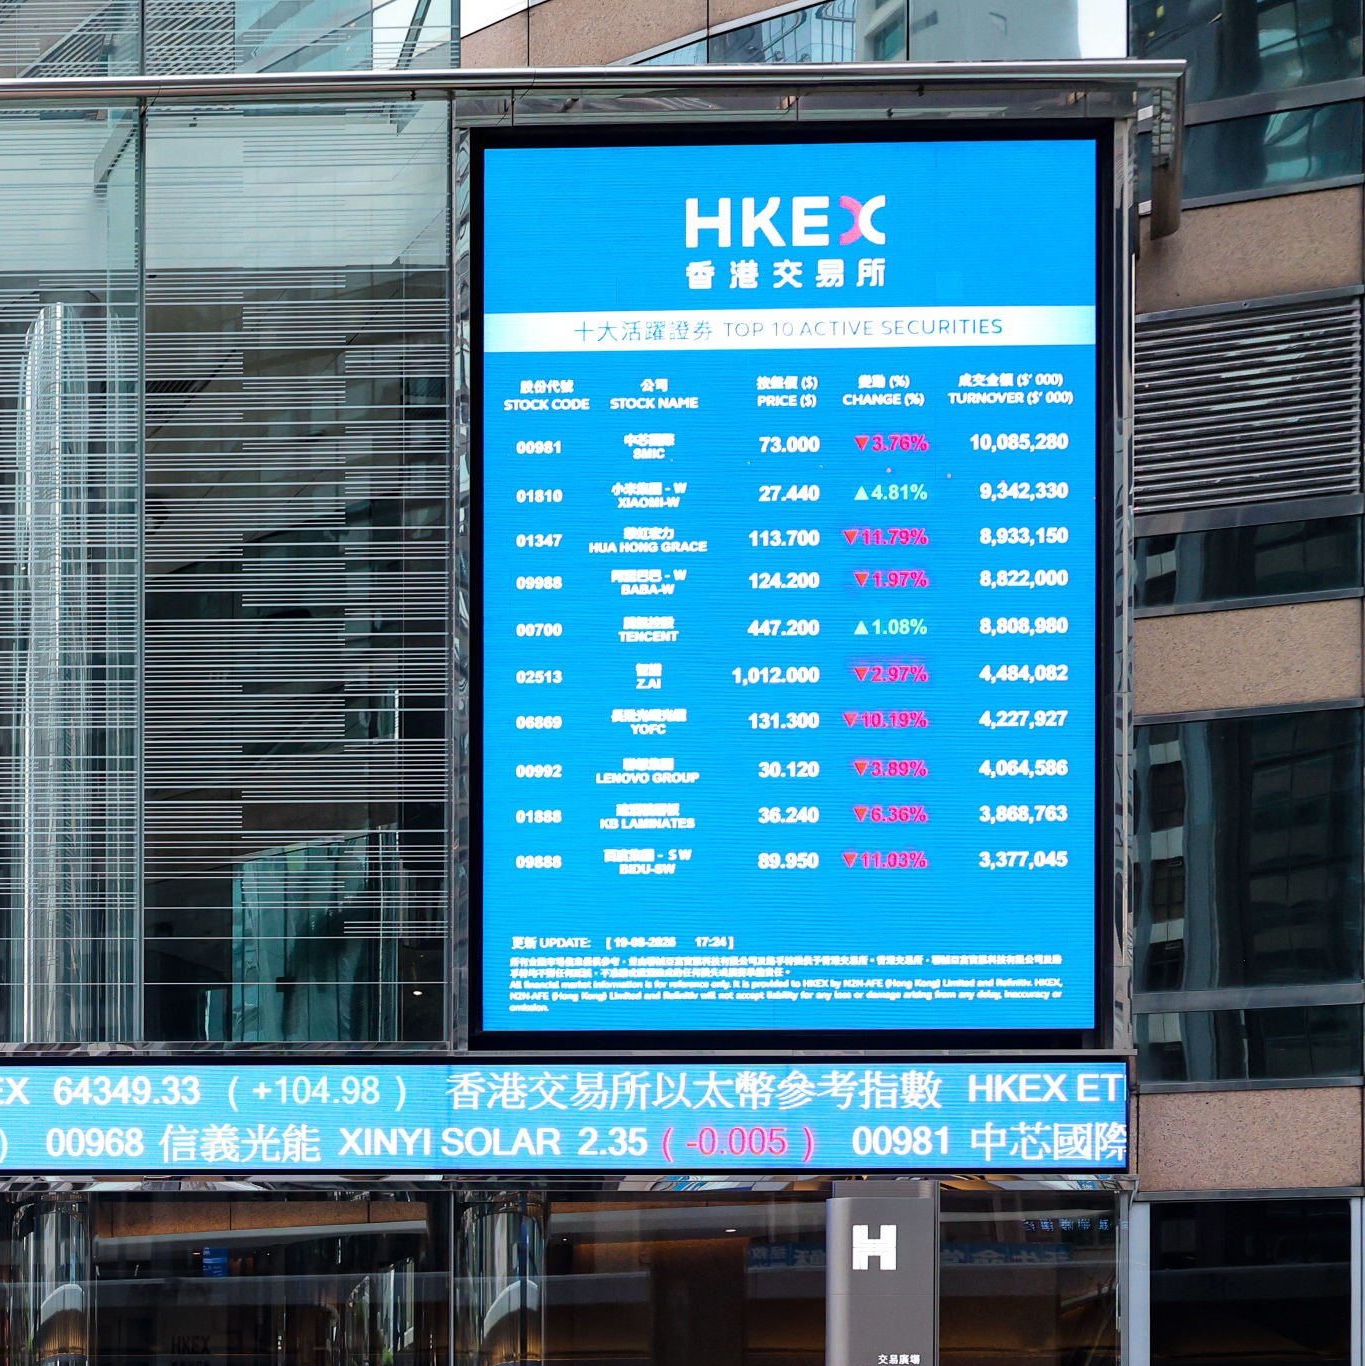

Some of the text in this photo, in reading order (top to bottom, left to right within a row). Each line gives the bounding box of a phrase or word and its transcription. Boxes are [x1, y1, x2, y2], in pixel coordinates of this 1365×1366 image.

[686, 195, 885, 248] HKEX
[686, 258, 885, 289] 香港交易所
[573, 318, 1003, 343] 十大活躍證券 TOP 10 ACTIVE SECURITIES
[641, 379, 668, 392] 公司
[504, 399, 589, 410] STOCK CODE
[610, 397, 698, 409] STOCK NAME
[758, 395, 797, 406] PRICE
[843, 394, 901, 405] CHANGE
[948, 392, 1024, 404] TURNOVER
[517, 441, 561, 454] 00981
[759, 436, 820, 452] 73.000
[873, 435, 929, 451] 3.76%
[971, 433, 1069, 452] 10,085,280
[633, 448, 665, 459] SMIC
[517, 489, 563, 502] 01810
[759, 485, 820, 501] 27.440
[872, 484, 927, 499] 4.81%
[980, 480, 1068, 501] 9,342,330
[618, 497, 680, 508] XIAOMI-W
[517, 534, 562, 547] 01347
[749, 530, 820, 546] 113.700
[861, 529, 929, 544] 11.79%
[980, 527, 1068, 546] 8,933,150
[589, 541, 707, 553] HUA HONG GRACE
[749, 572, 820, 588] 124.200
[873, 571, 929, 587] 1.97%
[980, 570, 1068, 588] 8,822,000
[621, 584, 675, 595] BABA-W
[517, 623, 562, 636] 00700
[748, 620, 819, 636] 447.200
[873, 619, 927, 634] 1.08%
[980, 617, 1068, 636] 8,808,980
[619, 631, 679, 642] TENCENT
[516, 670, 562, 683] 02513
[732, 667, 820, 686] 1,012.000
[872, 666, 927, 682] 2.97%
[979, 665, 1068, 683] 4,484,082
[636, 679, 661, 689] Z.AI
[749, 712, 819, 729] 131.300
[862, 711, 928, 728] 10.19%
[979, 710, 1068, 729] 4,227,927
[631, 724, 666, 734] YOFC
[516, 765, 562, 777] 00992
[759, 761, 819, 777] 30.120
[871, 761, 927, 776] 3.89%
[979, 760, 1068, 778] 4,064,586
[596, 772, 699, 783] LENOVO GROUP
[759, 807, 819, 823] 36.240
[871, 806, 926, 822] 6.36%
[980, 805, 1068, 824] 3,868,763
[600, 818, 695, 829] KB LAMINATES
[758, 853, 819, 869] 89.950
[861, 852, 926, 868] 11.03%
[979, 851, 1068, 869] 3,377,045
[620, 864, 676, 874] BIDU-SW
[540, 937, 727, 948] UPDATE: 17:24
[54, 1076, 200, 1105] 64349.33
[253, 1076, 379, 1104] +104.98
[447, 1071, 942, 1110] 香港交易所以太幣參考指數
[969, 1074, 1067, 1101] HKEX
[1078, 1074, 1127, 1101] ET
[46, 1128, 144, 1156] 00968
[159, 1124, 321, 1163] 信義光能
[339, 1128, 430, 1155] XINYI
[442, 1128, 560, 1155] SOLAR
[578, 1127, 647, 1155] 2.35
[687, 1128, 785, 1154] -0.005
[853, 1126, 948, 1155] 00981
